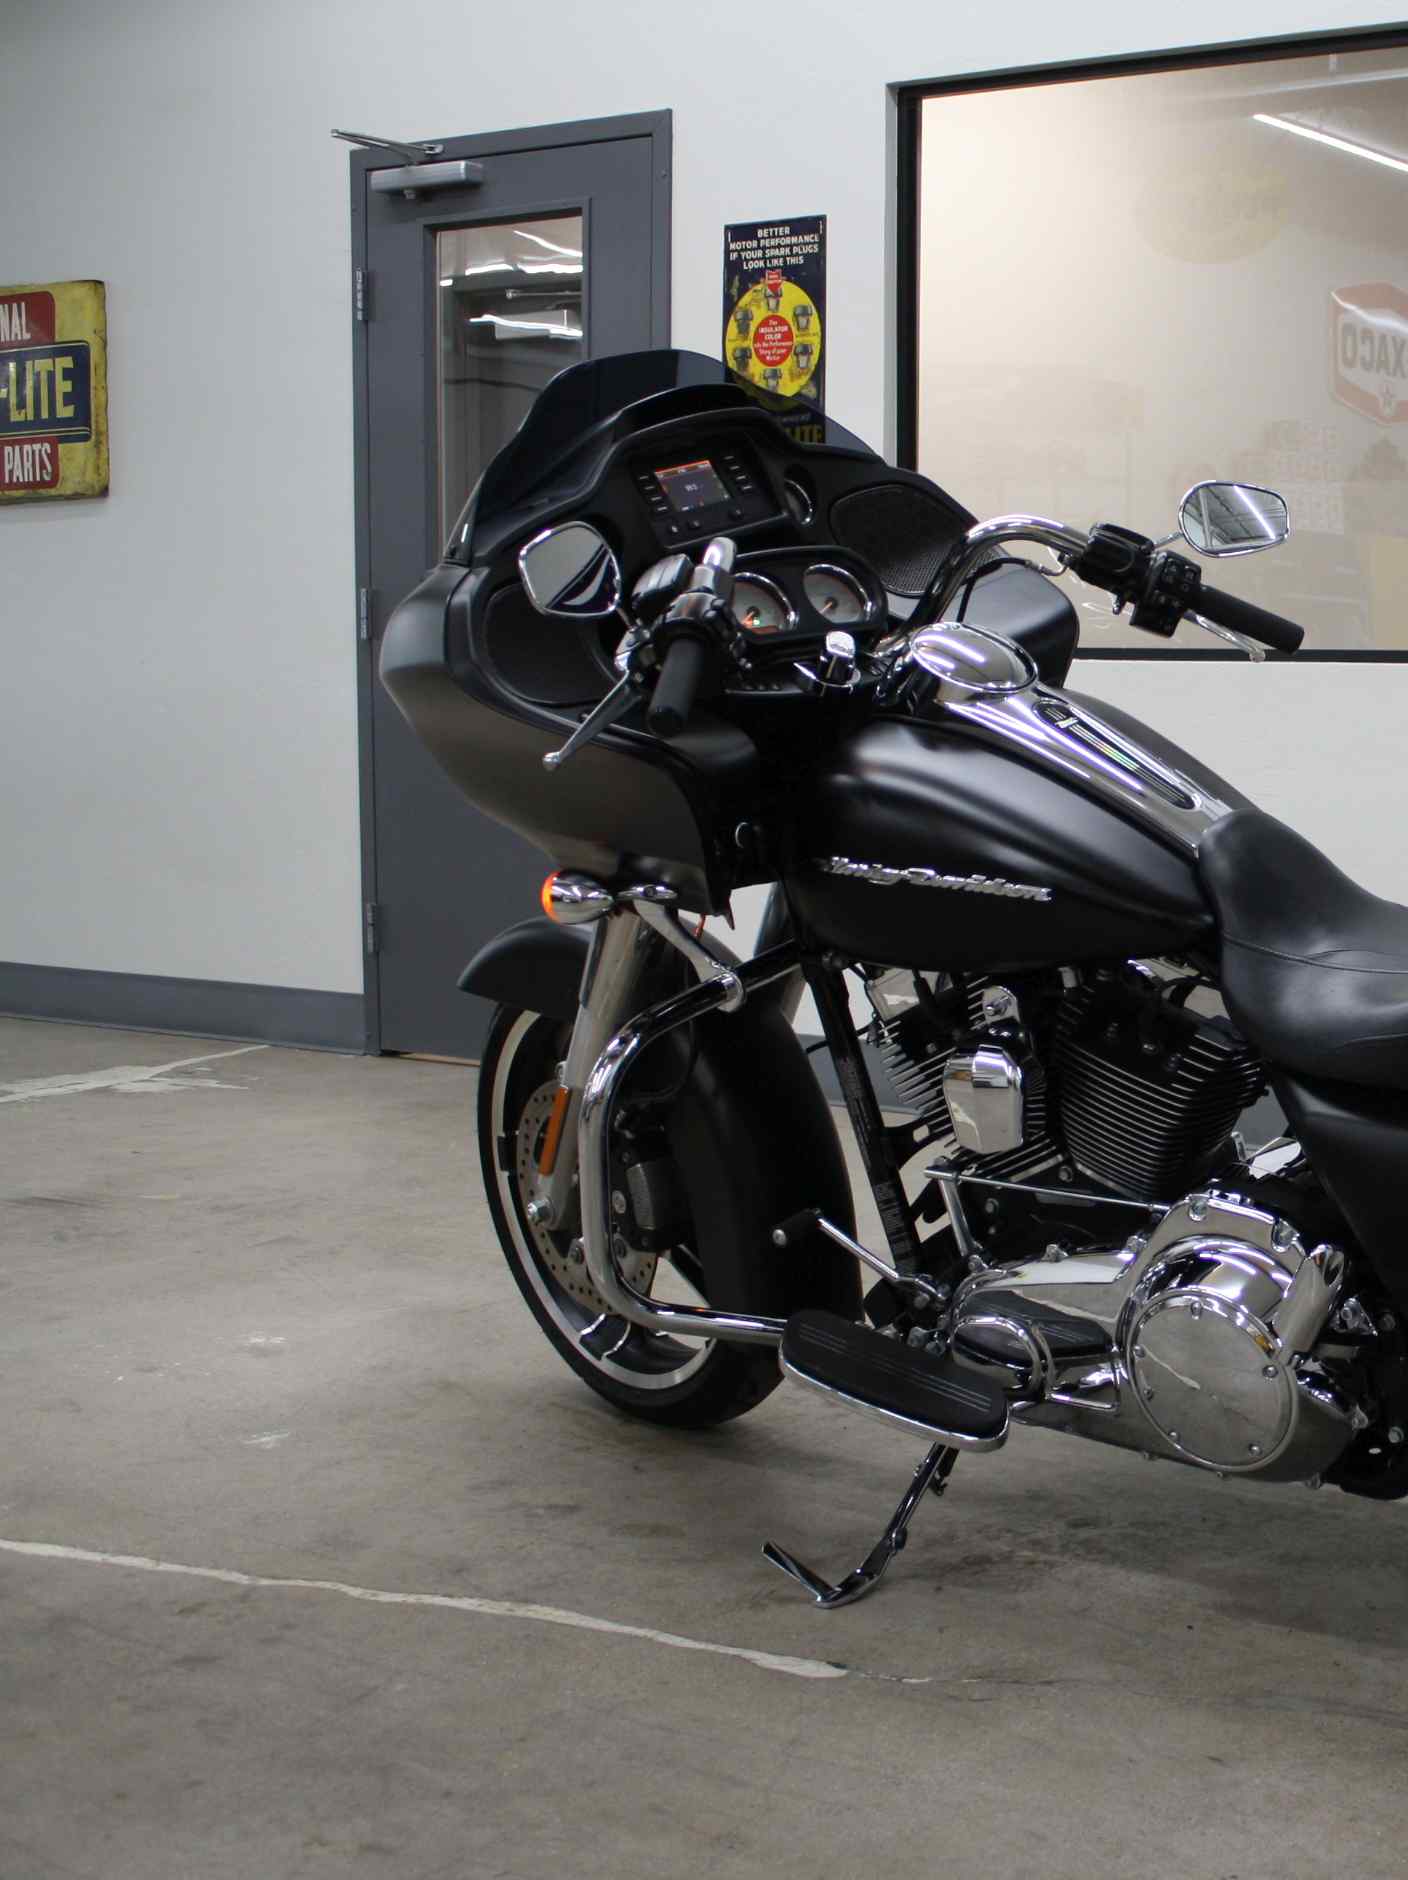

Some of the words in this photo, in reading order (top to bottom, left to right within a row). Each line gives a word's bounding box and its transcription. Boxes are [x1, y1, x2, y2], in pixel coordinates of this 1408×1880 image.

[757, 226, 790, 238] BETTER
[729, 240, 758, 251] MOTOR
[760, 233, 819, 248] PERFORMANCE
[729, 252, 738, 261] IF
[740, 250, 763, 260] YOUR
[765, 246, 791, 258] SPARK
[792, 244, 819, 254] PLUGS
[743, 260, 765, 270] LOOK
[766, 257, 784, 267] LIKE
[785, 255, 804, 265] THIS
[4, 442, 52, 483] PARTS
